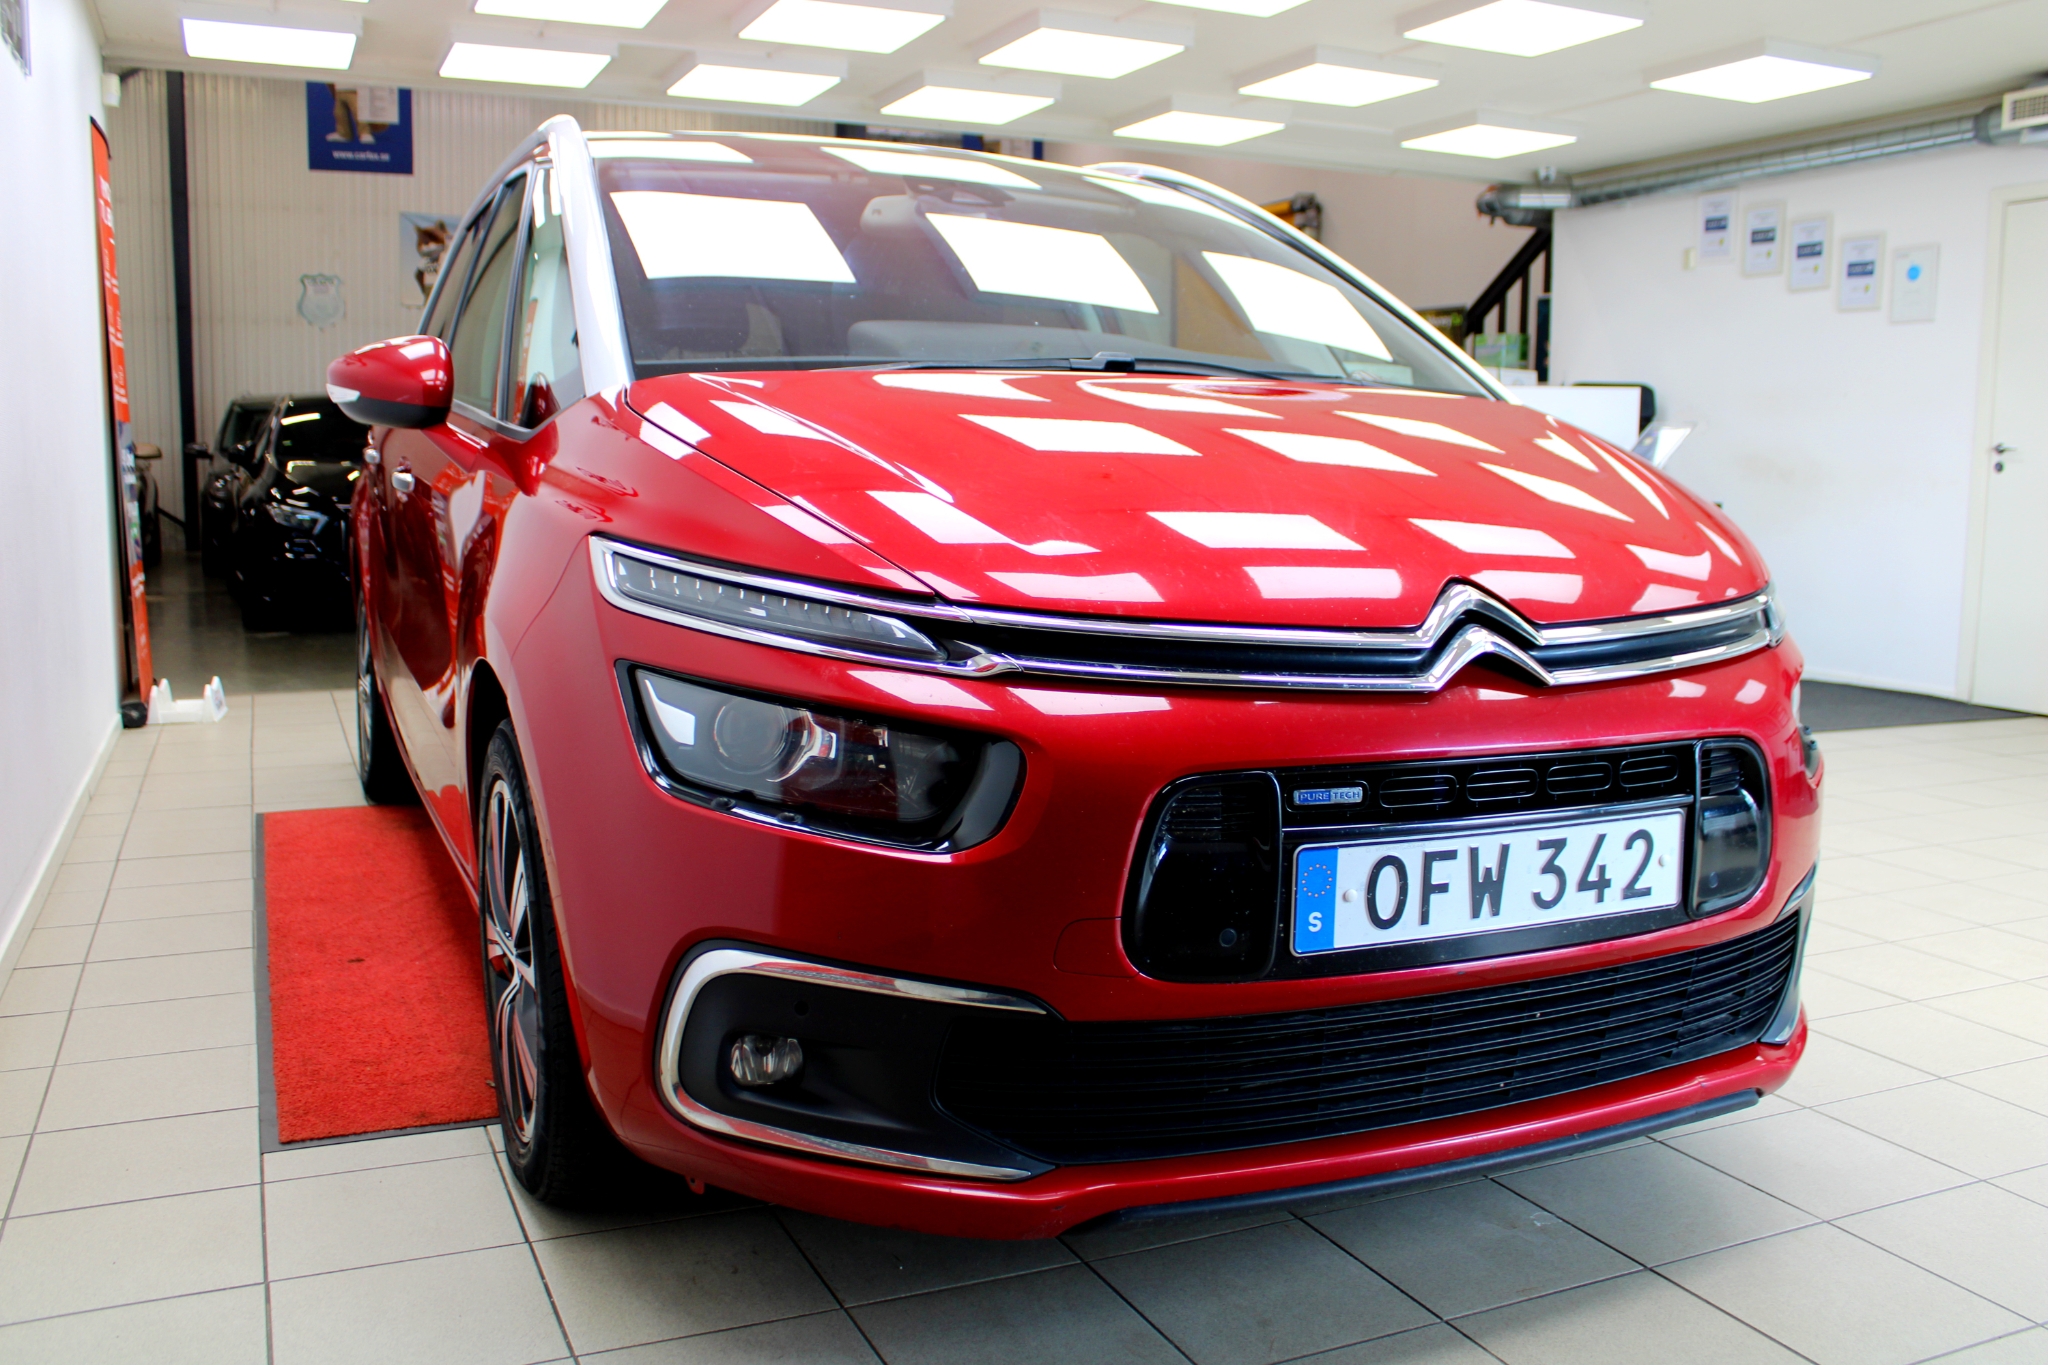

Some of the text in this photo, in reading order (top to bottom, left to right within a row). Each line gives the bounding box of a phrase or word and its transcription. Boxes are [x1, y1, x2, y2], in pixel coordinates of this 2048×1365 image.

[1366, 828, 1655, 930] OFW 342
[1308, 911, 1323, 932] S
